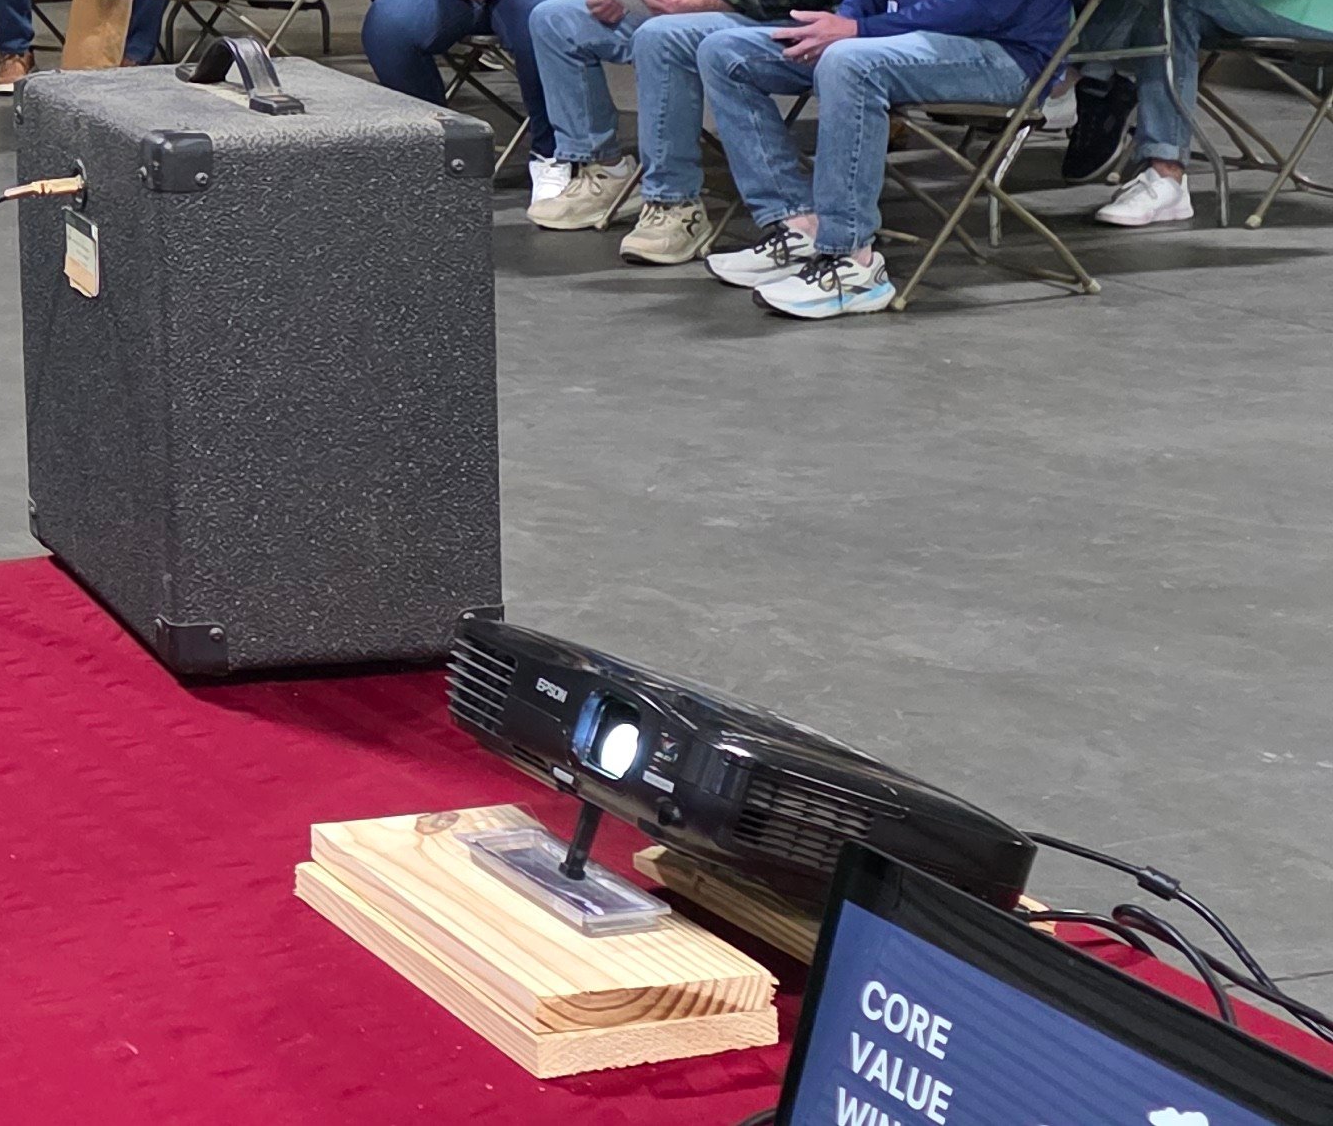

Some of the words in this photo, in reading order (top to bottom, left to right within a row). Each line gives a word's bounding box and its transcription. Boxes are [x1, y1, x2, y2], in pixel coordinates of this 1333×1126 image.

[535, 677, 568, 704] EPSON
[860, 980, 953, 1060] CORE
[836, 1086, 903, 1126] WI
[850, 1032, 954, 1126] VALUE
